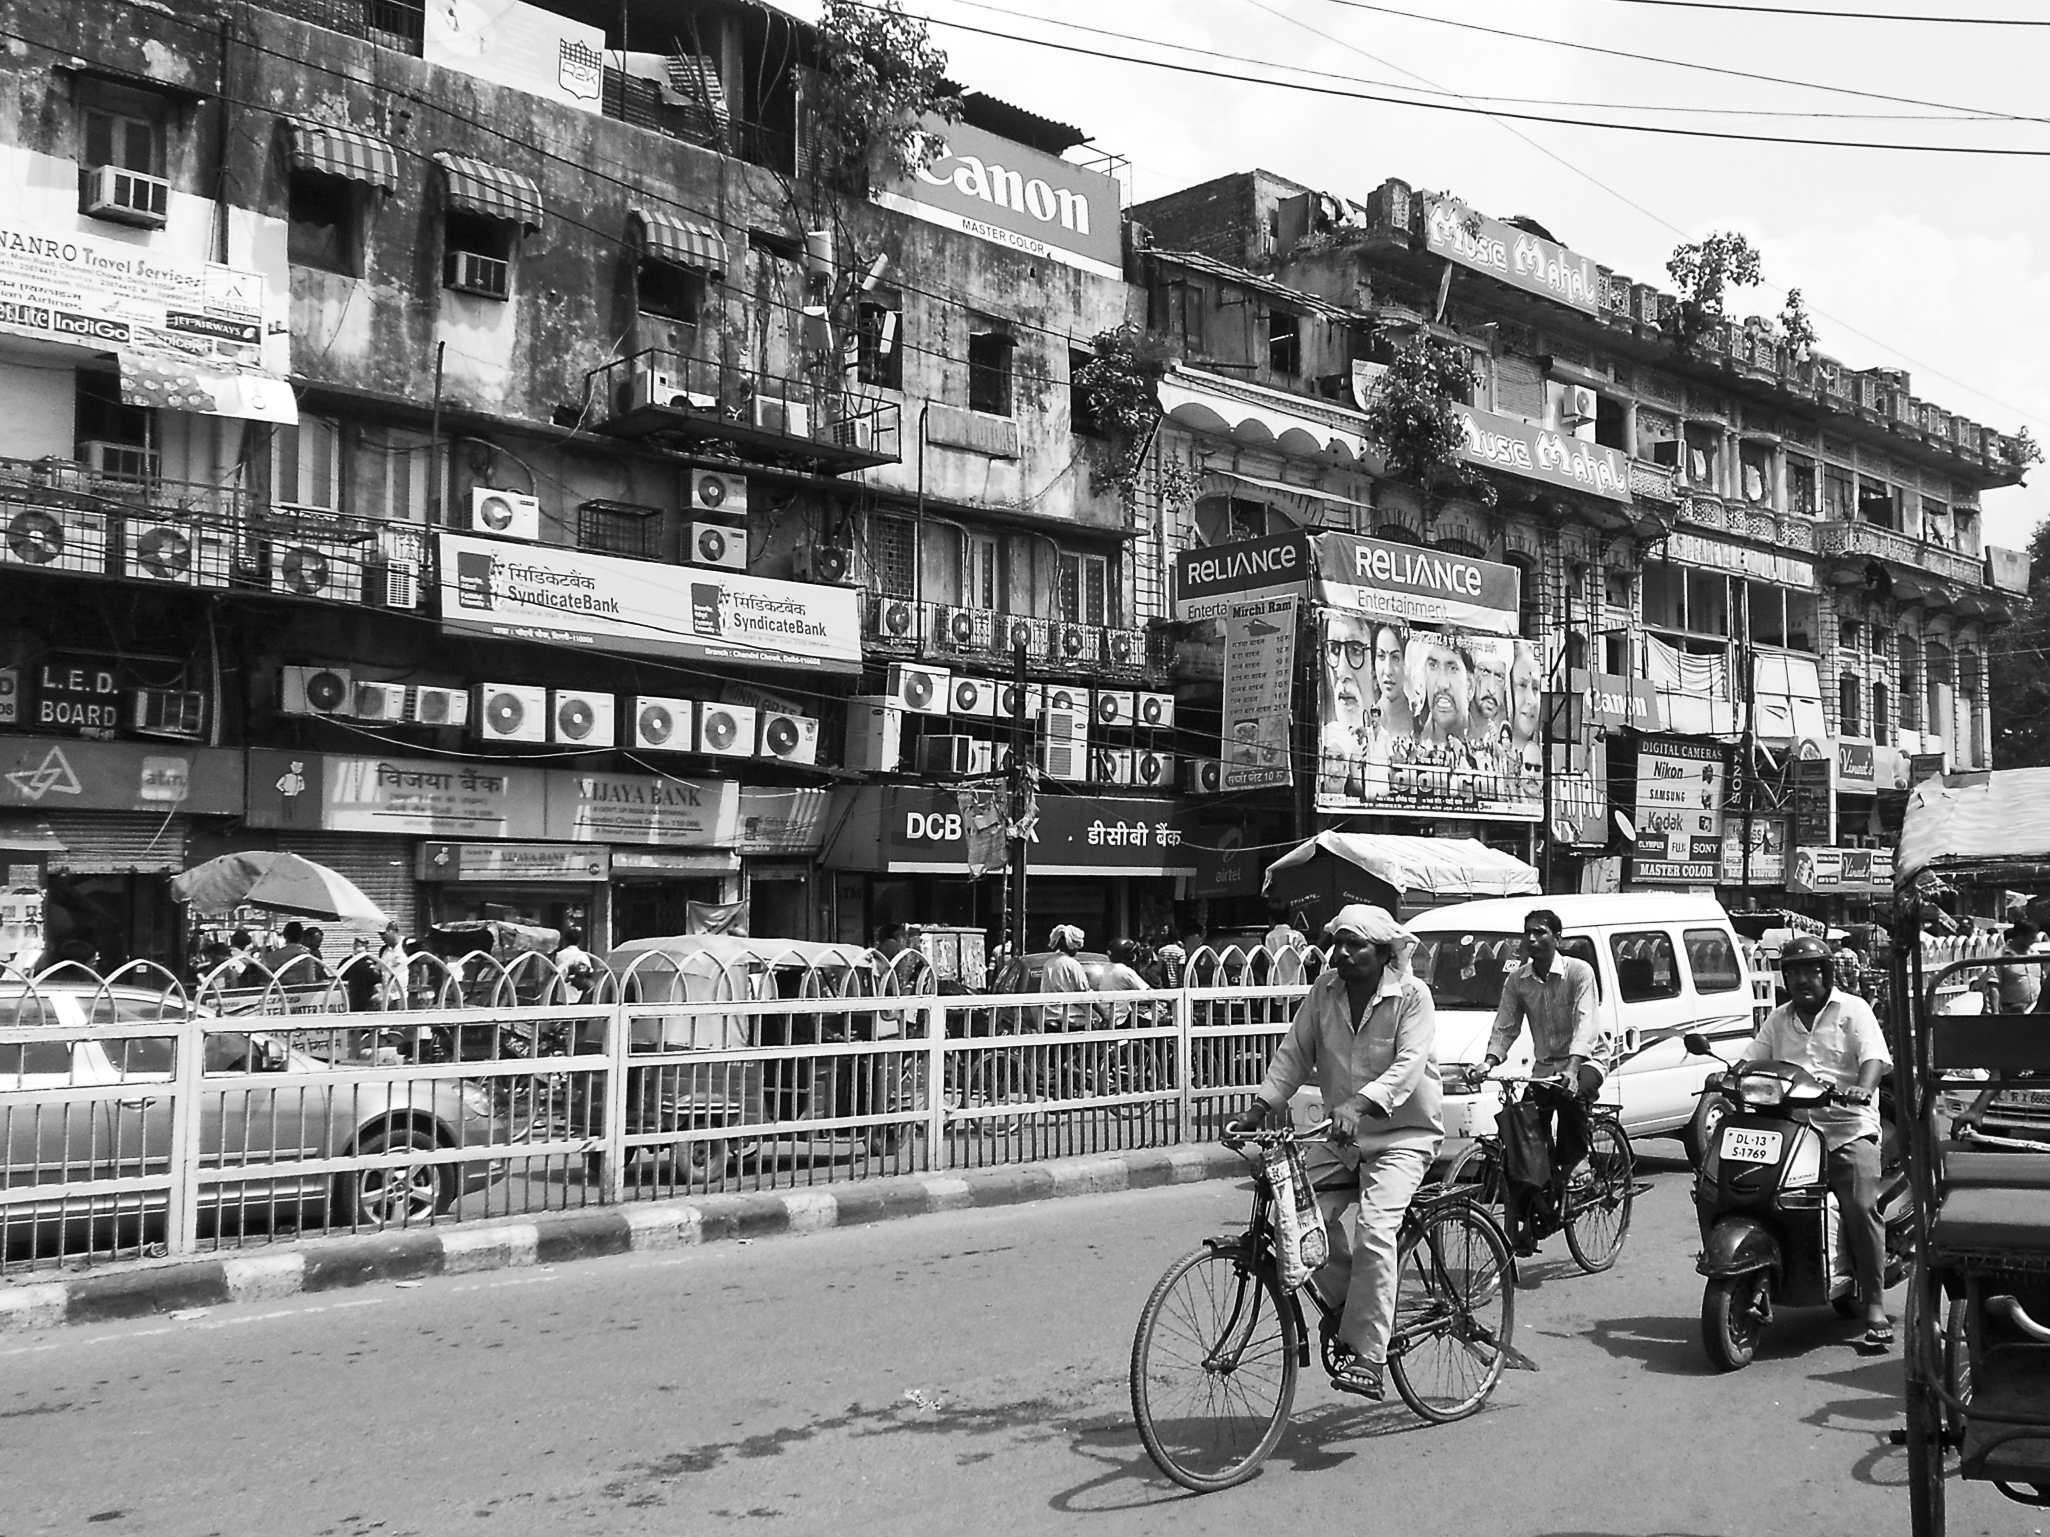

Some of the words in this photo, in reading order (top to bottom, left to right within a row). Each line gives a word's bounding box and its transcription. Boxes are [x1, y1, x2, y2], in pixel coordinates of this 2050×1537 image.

[904, 130, 1090, 235] Canon
[961, 219, 1007, 242] MASTER
[1009, 234, 1045, 255] COLOR
[83, 247, 131, 273] Travel
[55, 312, 130, 341] IndiGo
[193, 319, 241, 336] AIRWAYS
[507, 585, 620, 614] SyndicateBank
[1232, 602, 1265, 619] Mirchi
[1267, 600, 1292, 614] Ram
[1357, 589, 1448, 619] Entertainment
[733, 612, 828, 637] SyndicateBank
[705, 647, 729, 658] Branch
[733, 650, 759, 660] Chandni
[42, 666, 119, 695] L.E.D.
[41, 700, 117, 727] BOARD
[1642, 741, 1680, 756] DIGITAL
[1681, 745, 1723, 760] CAMERAS
[375, 762, 453, 790] विजया
[458, 766, 504, 794] बैंक
[1264, 770, 1274, 782] 10
[1653, 760, 1684, 780] Nikon
[579, 780, 645, 804] VIJAYA
[650, 786, 701, 807] BANK
[1649, 788, 1686, 802] SAMSUNG
[906, 812, 963, 841] DCB
[1087, 819, 1149, 846] डीसीबी
[1155, 822, 1182, 847] बैंक
[1648, 811, 1684, 831] Kodak
[1692, 843, 1718, 854] SONY
[1215, 867, 1241, 883] airtel
[1639, 863, 1681, 876] MASTER
[1681, 865, 1714, 878] COLOR
